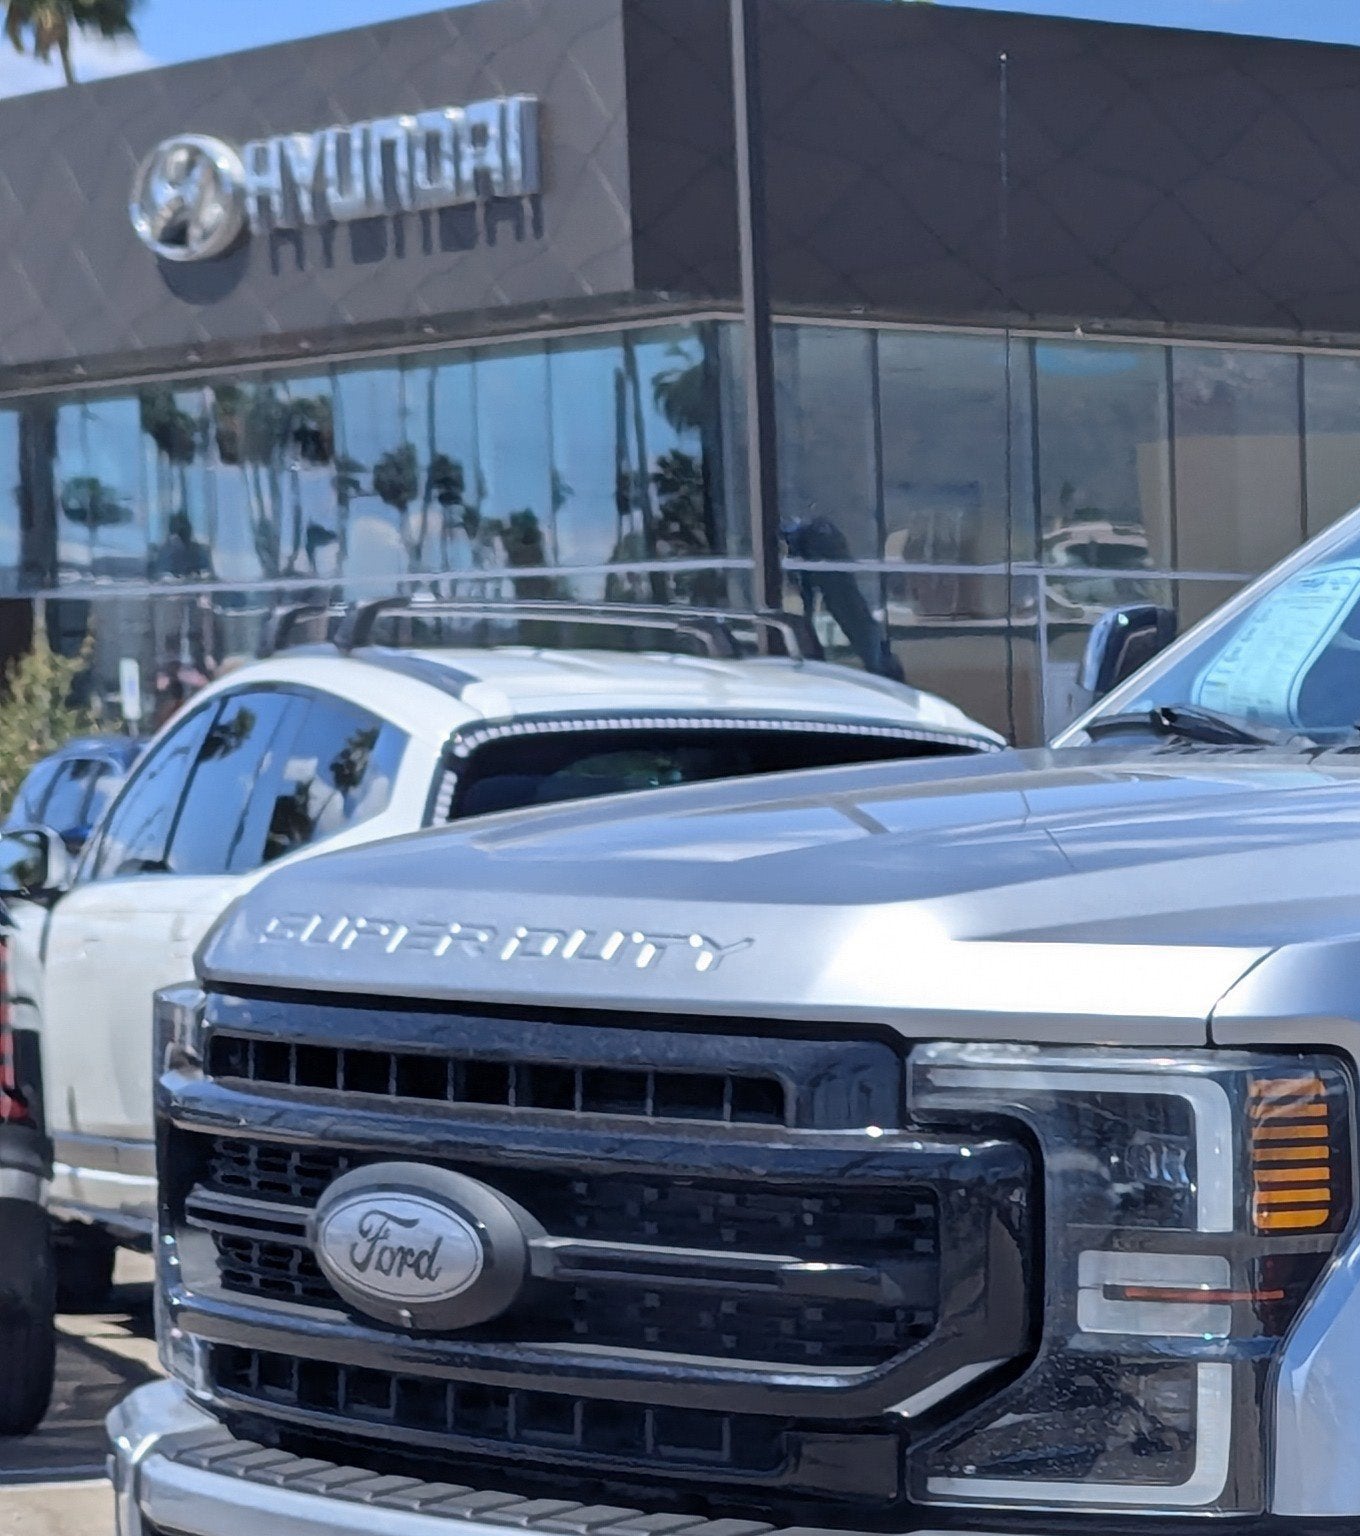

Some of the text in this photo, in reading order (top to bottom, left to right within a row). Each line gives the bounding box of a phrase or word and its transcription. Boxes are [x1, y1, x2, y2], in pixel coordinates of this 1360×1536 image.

[243, 93, 540, 235] HYUNDAI
[260, 912, 757, 972] SUPER DUTY
[350, 1208, 445, 1282] Ford
